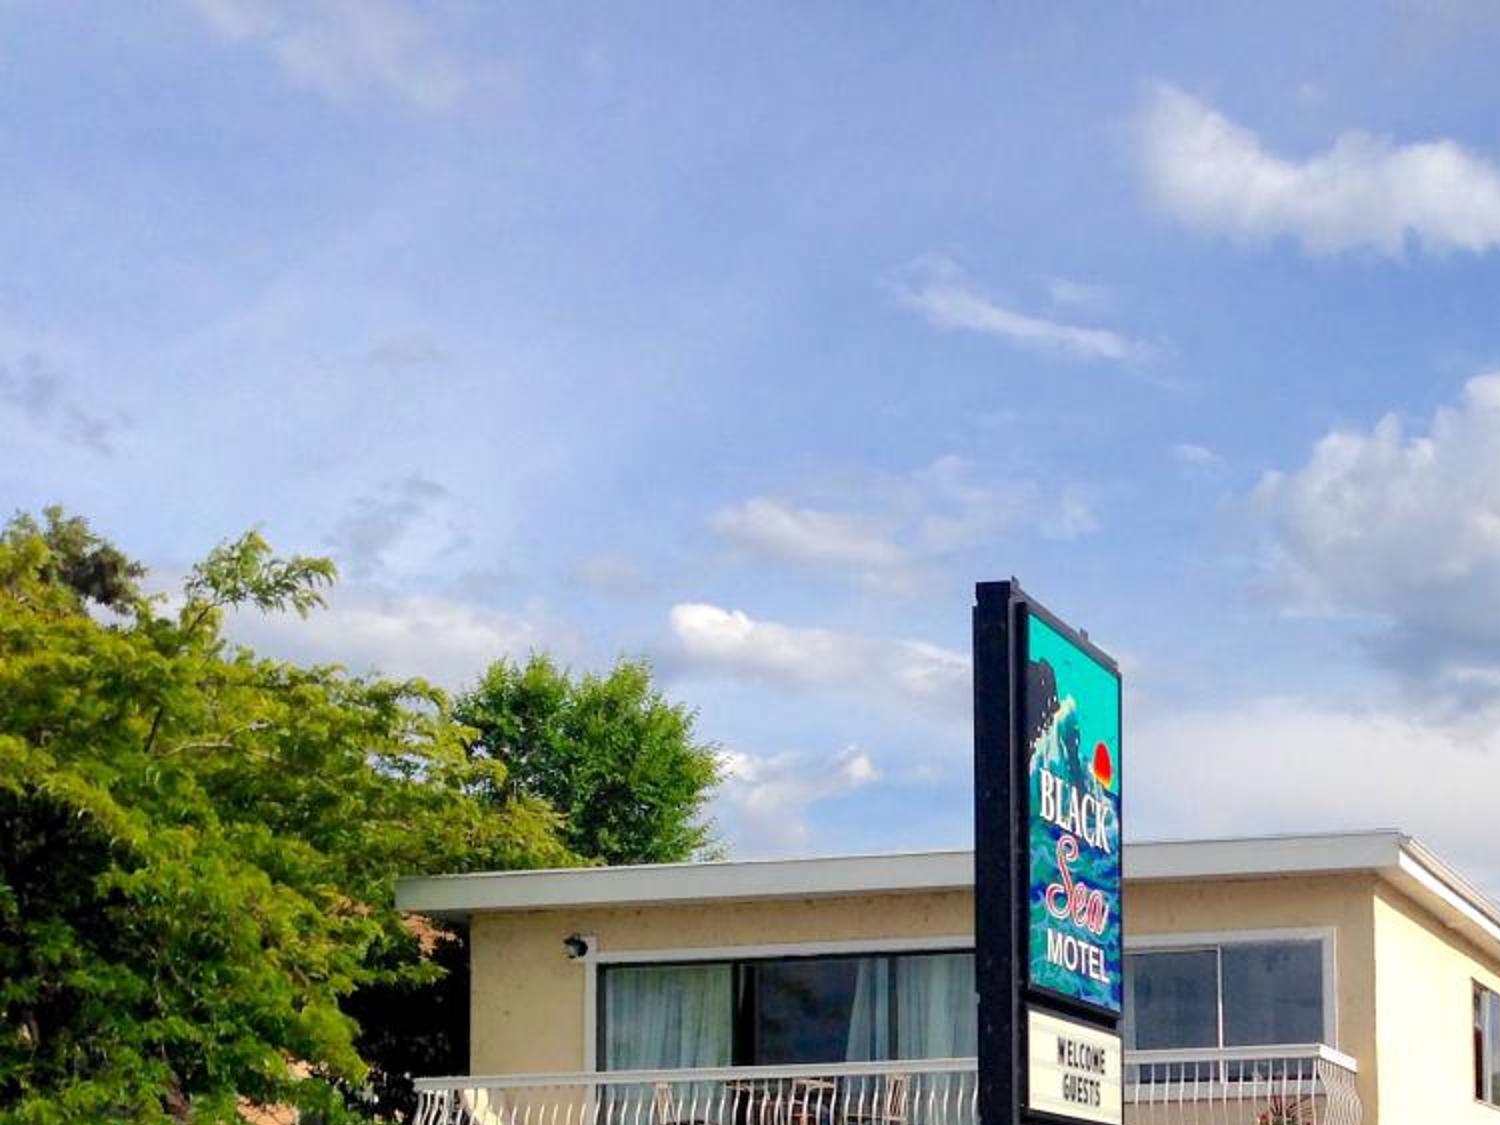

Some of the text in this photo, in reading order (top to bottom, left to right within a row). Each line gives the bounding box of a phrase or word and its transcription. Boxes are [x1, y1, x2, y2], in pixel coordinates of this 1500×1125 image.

[1040, 767, 1110, 853] BLACK
[1046, 835, 1109, 935] Sea
[1047, 928, 1110, 984] MOTEL
[1057, 1036, 1106, 1075] WELCOME
[1063, 1074, 1101, 1107] GUESTS
